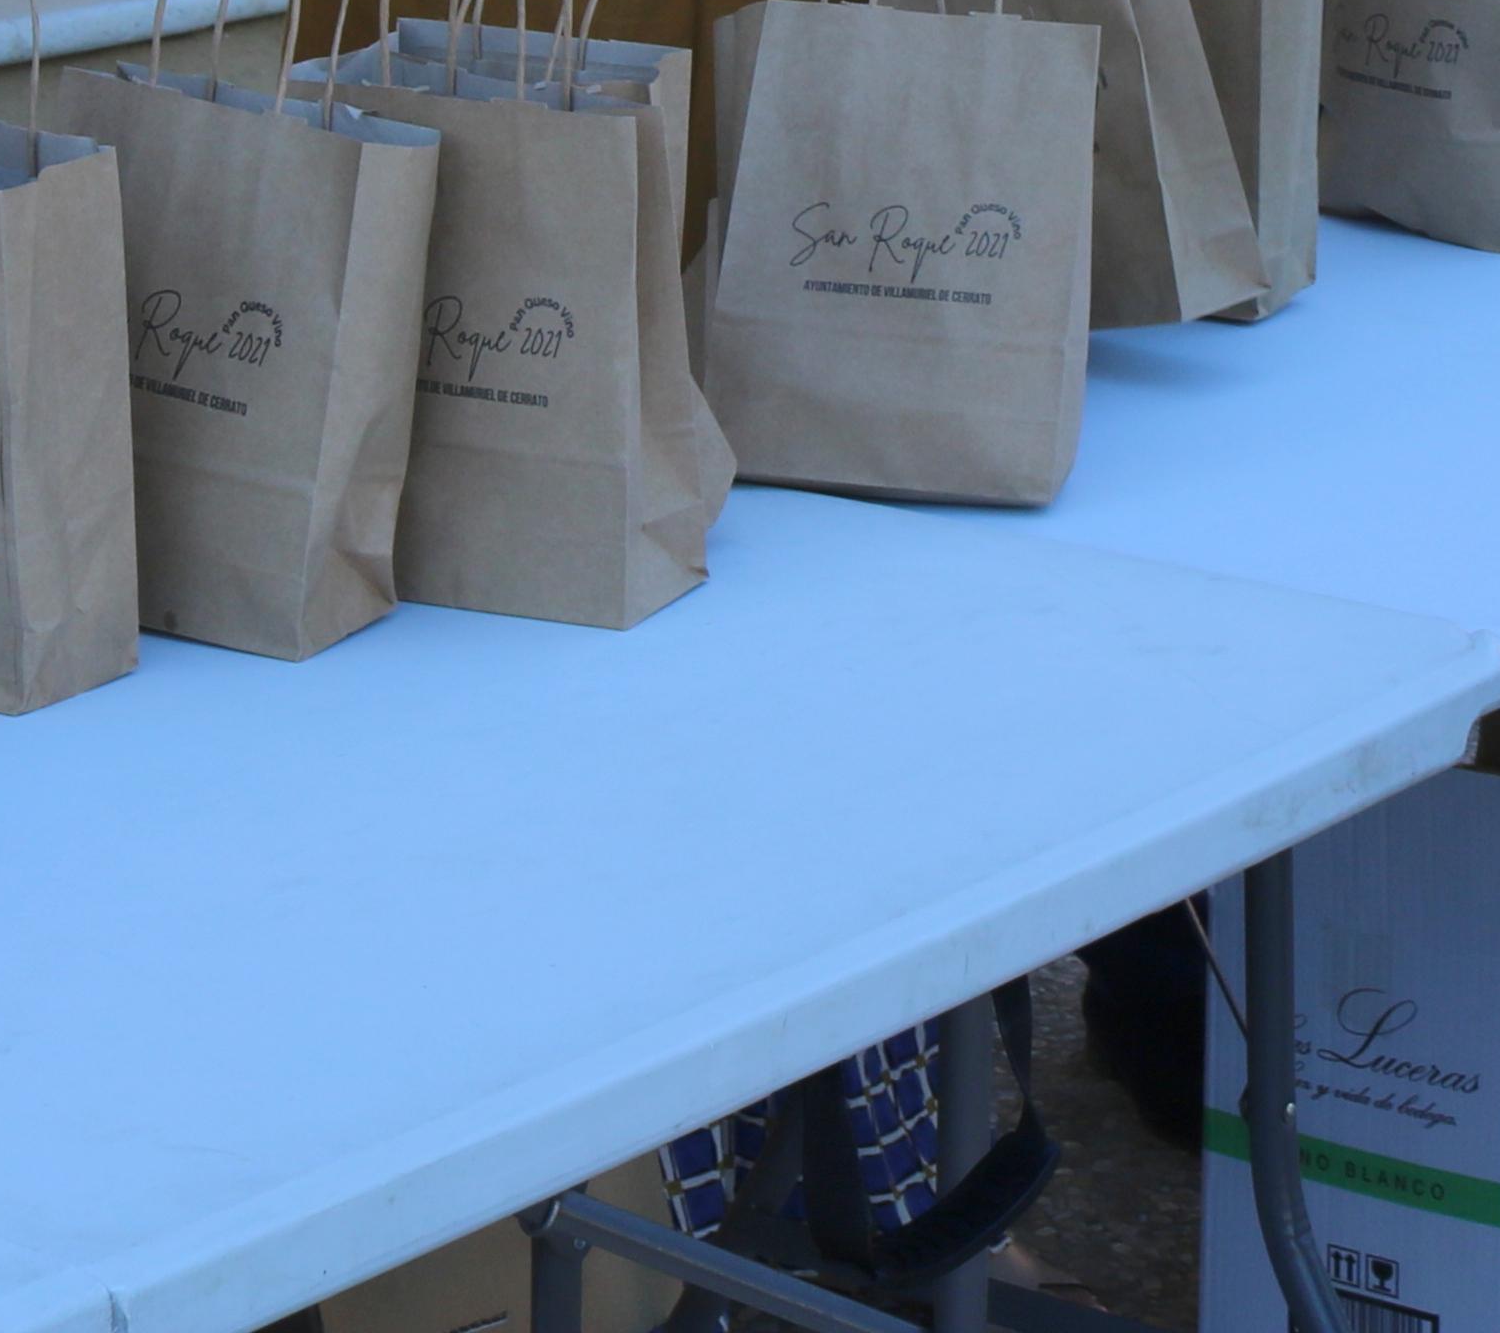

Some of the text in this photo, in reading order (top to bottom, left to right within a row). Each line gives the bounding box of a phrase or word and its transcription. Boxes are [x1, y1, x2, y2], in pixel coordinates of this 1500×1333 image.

[790, 202, 1010, 284] San Roque 2021
[524, 297, 561, 311] Queso
[802, 279, 993, 305] AYUNTAMIENTO DE VILLAMURIEL DE CERRATO
[134, 289, 271, 381] Roque 2021
[221, 311, 241, 334] Pan
[240, 301, 273, 317] Queso
[424, 295, 563, 382] Roque 2021
[197, 391, 209, 408] DE
[209, 393, 248, 416] CERRATO
[497, 389, 508, 403] DE
[510, 391, 549, 408] CERRATO
[1315, 987, 1482, 1094] Luceras
[1299, 1147, 1446, 1202] NO BLANCO
